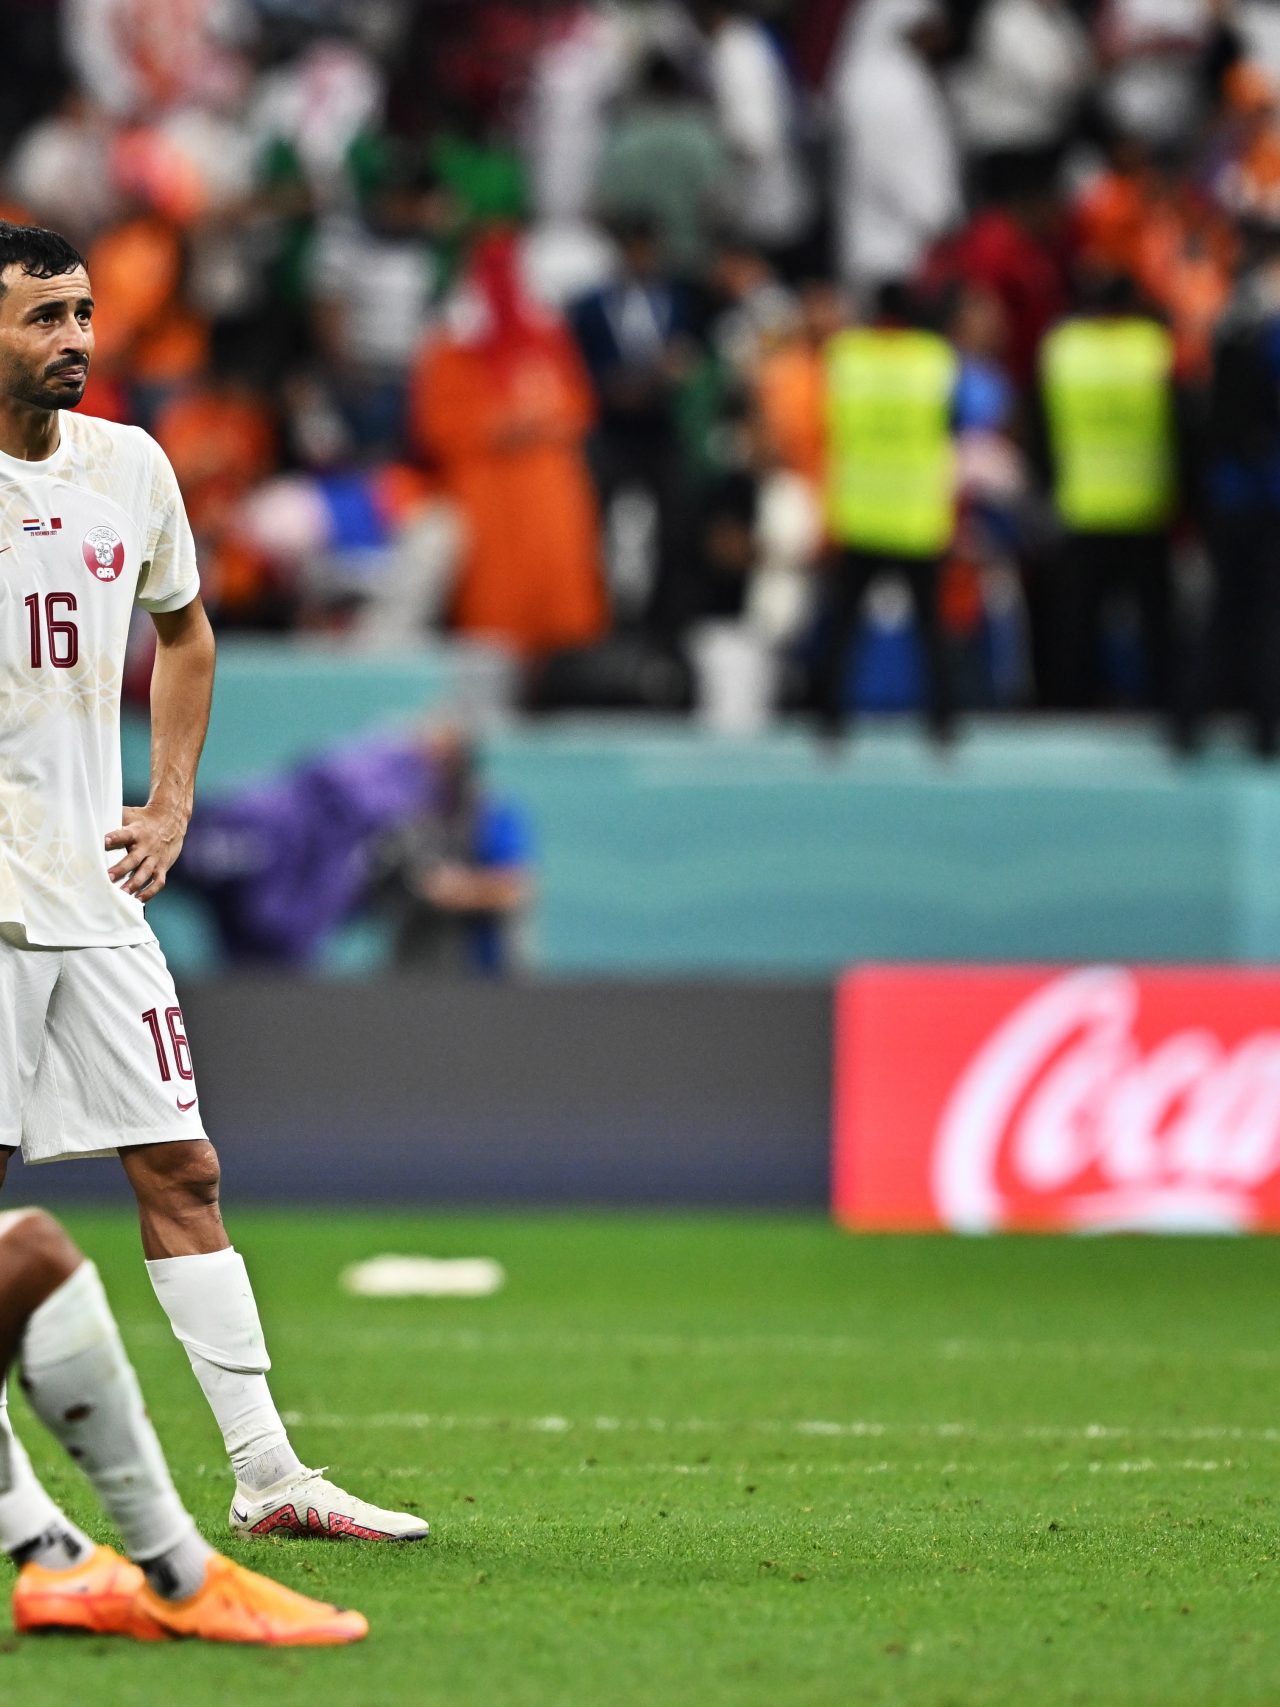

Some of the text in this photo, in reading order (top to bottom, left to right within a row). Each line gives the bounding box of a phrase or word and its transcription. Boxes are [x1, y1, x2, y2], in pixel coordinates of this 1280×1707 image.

[96, 567, 115, 578] QFA
[24, 591, 79, 669] 16
[142, 1006, 195, 1082] 16
[248, 1503, 397, 1541] AIR
